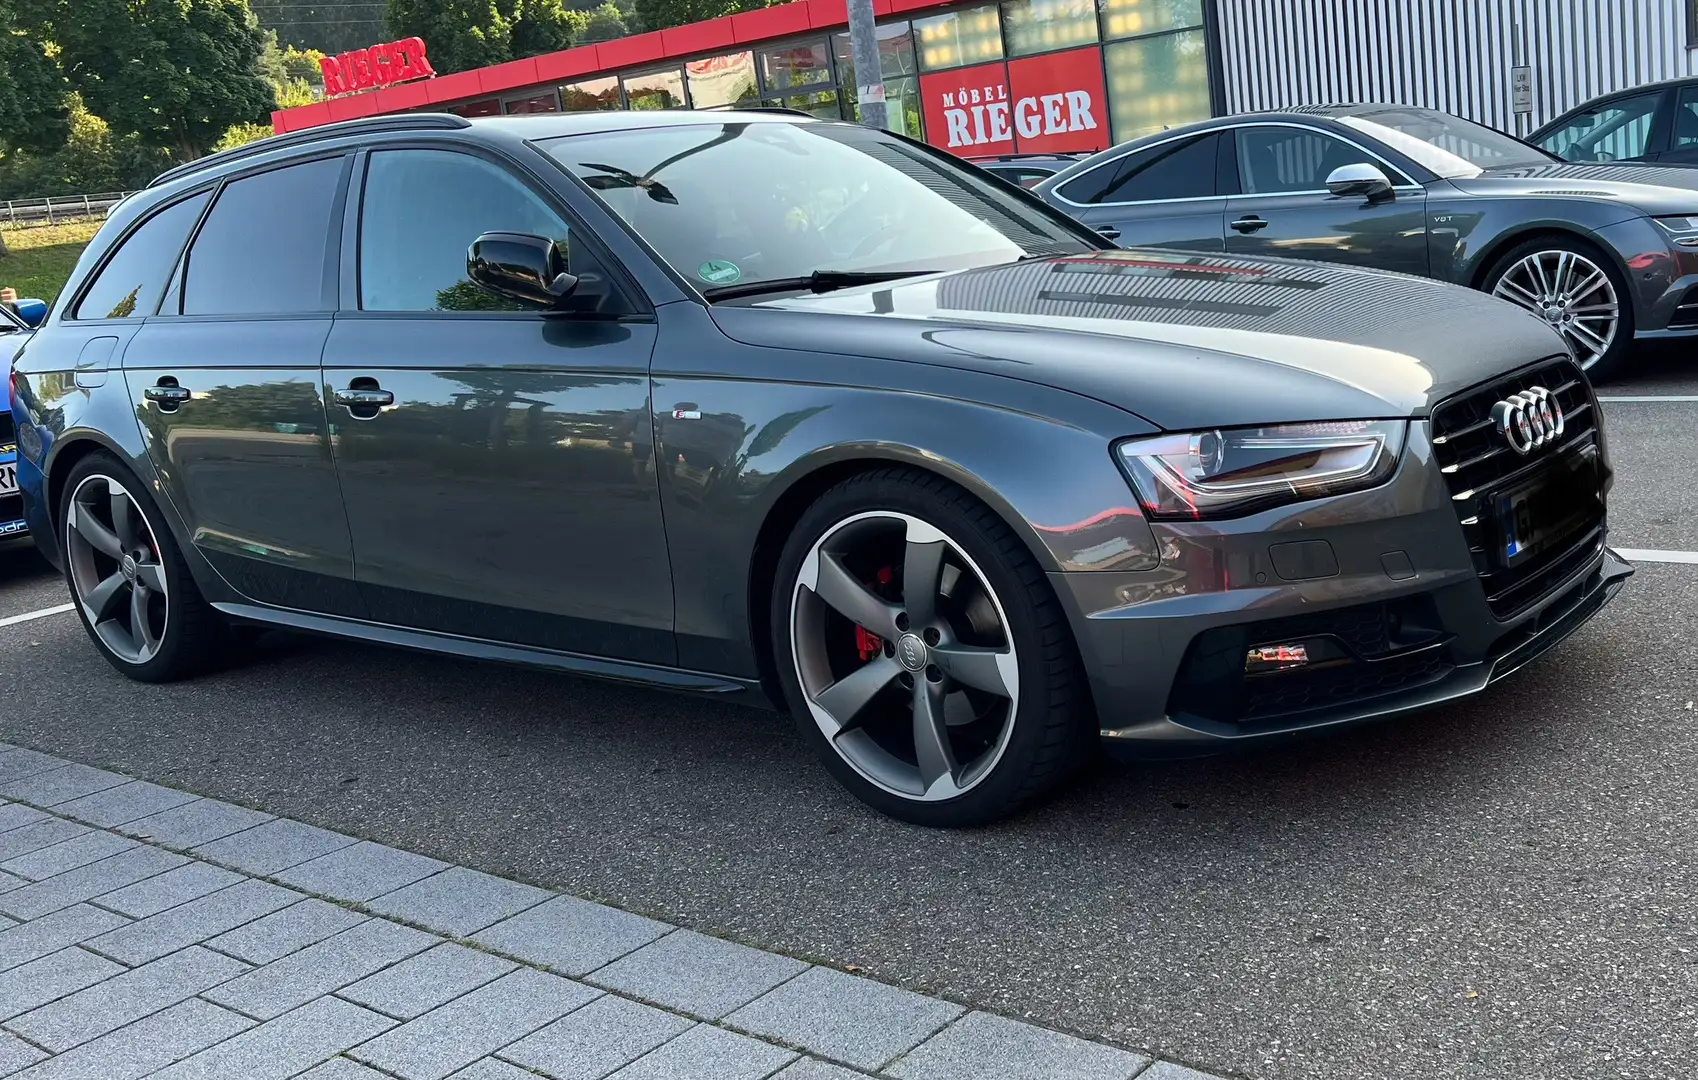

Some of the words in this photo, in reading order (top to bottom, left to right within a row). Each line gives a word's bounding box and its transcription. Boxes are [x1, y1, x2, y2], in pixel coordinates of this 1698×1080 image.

[319, 36, 436, 97] RIEGER
[942, 85, 1006, 107] MÖBEL
[944, 90, 1097, 148] RIEGER
